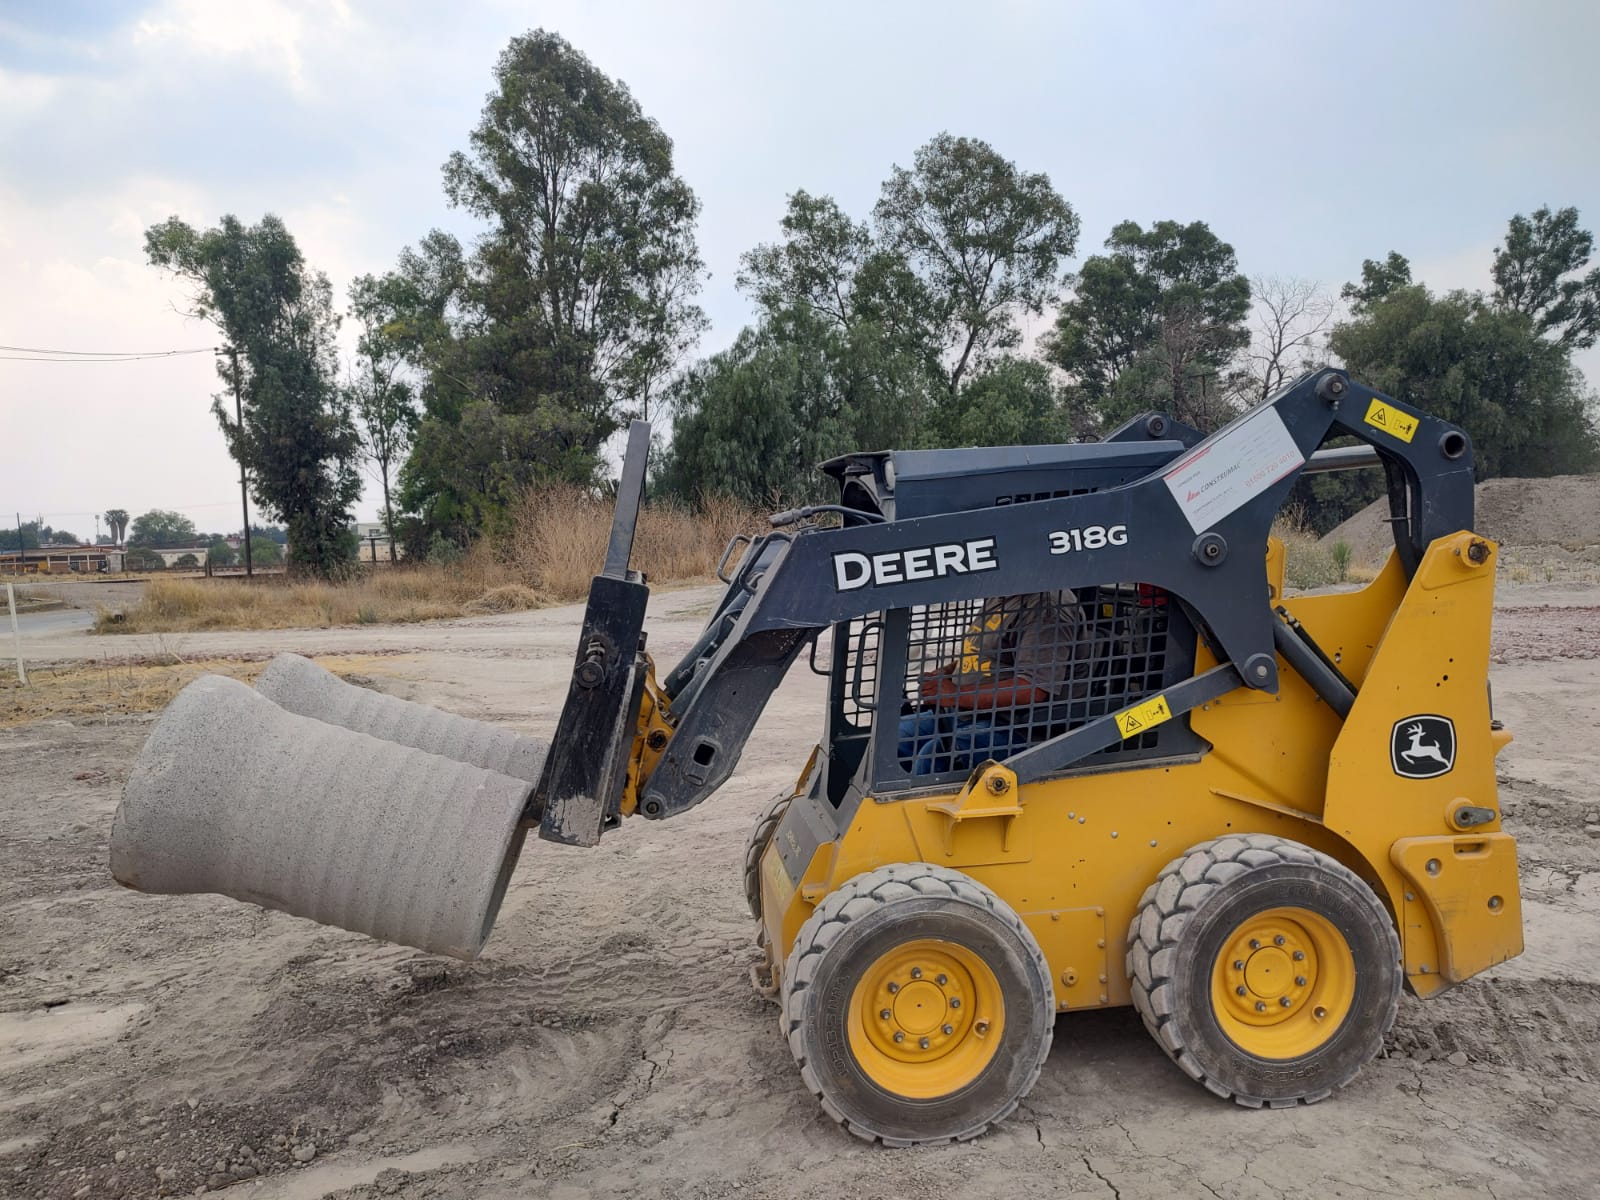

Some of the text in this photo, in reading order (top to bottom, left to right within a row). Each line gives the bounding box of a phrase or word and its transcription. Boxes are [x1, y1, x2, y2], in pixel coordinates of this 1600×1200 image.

[1200, 463, 1241, 493] CONSTRUMAC
[1049, 525, 1128, 555] 318G
[834, 539, 997, 591] DEERE
